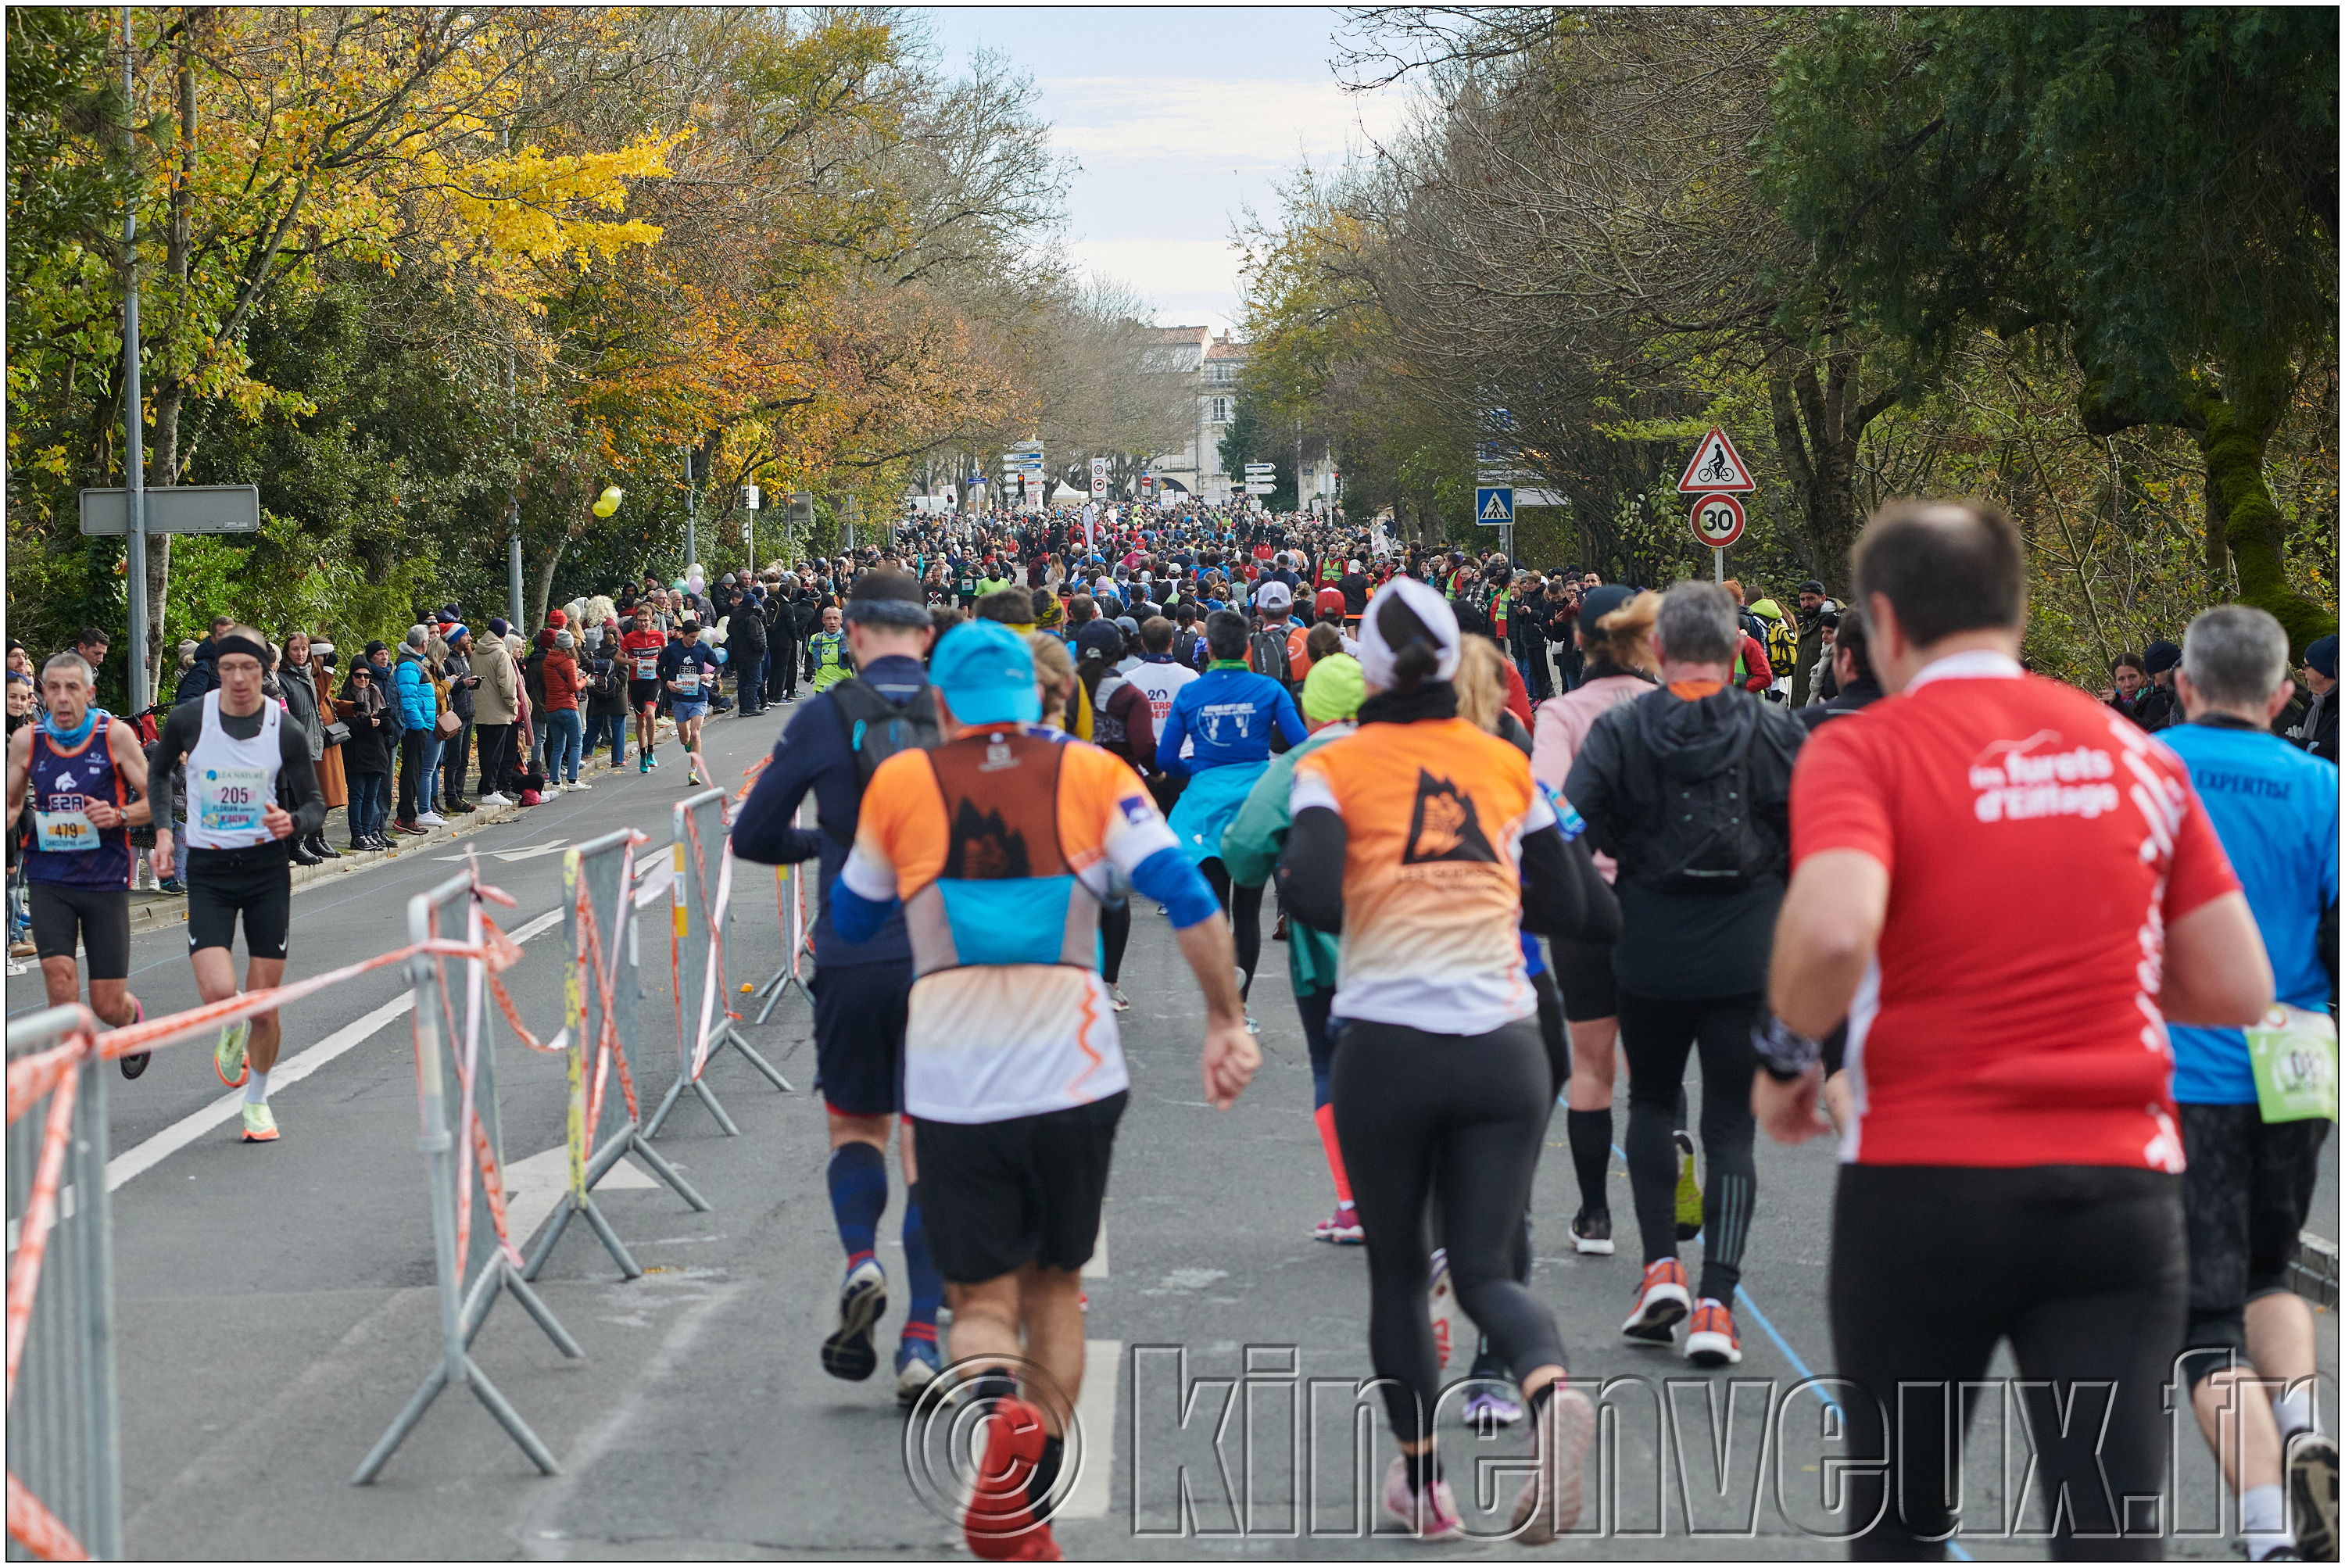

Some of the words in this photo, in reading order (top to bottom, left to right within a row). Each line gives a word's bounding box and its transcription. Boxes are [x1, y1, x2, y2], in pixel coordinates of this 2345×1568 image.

[1703, 510, 1733, 531] 30
[679, 665, 696, 674] E2A
[2004, 745, 2115, 784] furets
[2196, 769, 2293, 800] EXPERTISE
[48, 793, 84, 811] E2A
[220, 786, 249, 804] 205
[55, 823, 79, 839] 479
[45, 839, 77, 847] CHRISTOPHE
